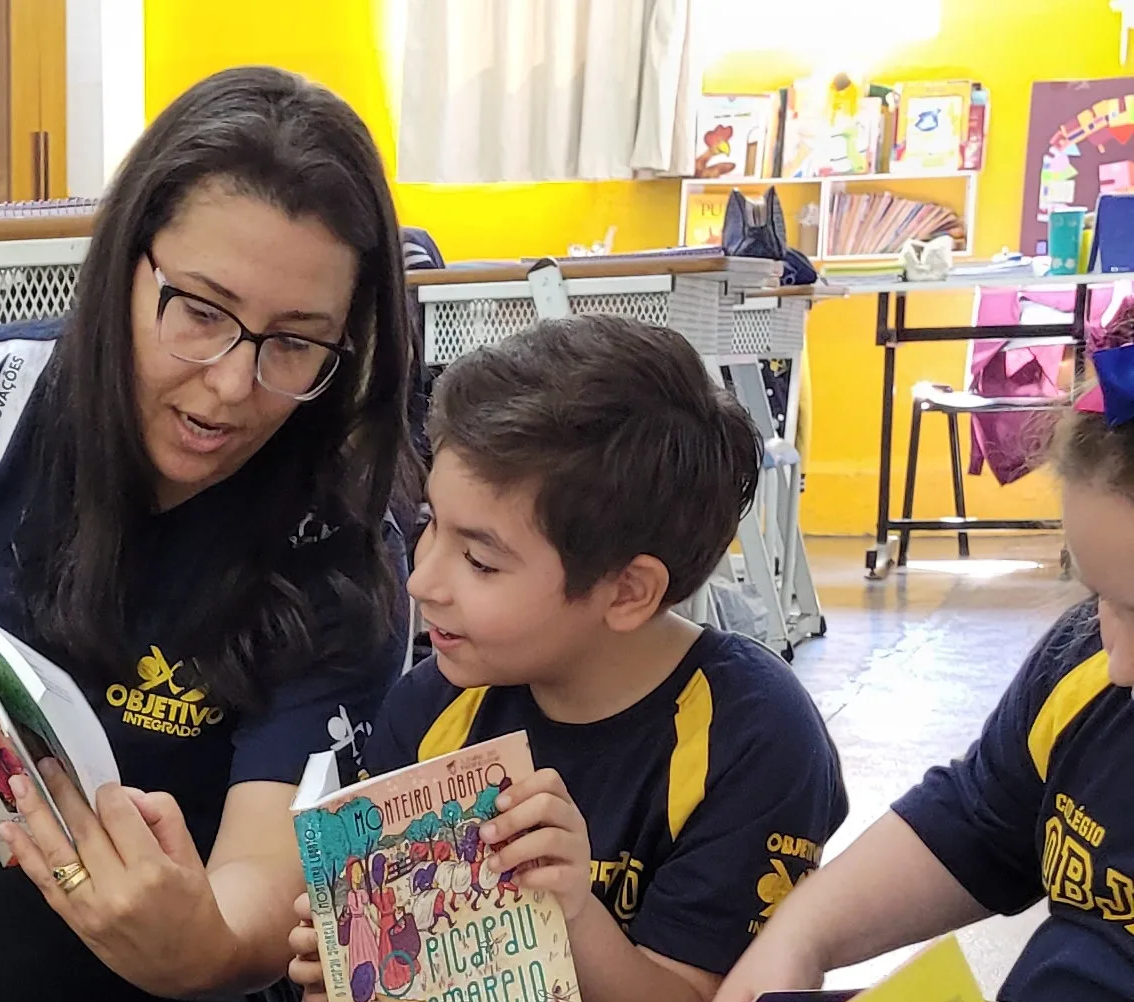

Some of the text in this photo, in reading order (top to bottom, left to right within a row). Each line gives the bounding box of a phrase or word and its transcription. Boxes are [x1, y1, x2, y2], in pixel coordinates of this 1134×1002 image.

[701, 203, 723, 216] PU
[106, 683, 223, 727] OBJETIVO
[122, 710, 201, 737] INTEGRADO
[354, 763, 507, 837] MONTEIRO LOBATO
[1055, 793, 1106, 848] COLÉGIO
[1042, 816, 1134, 922] OBJ
